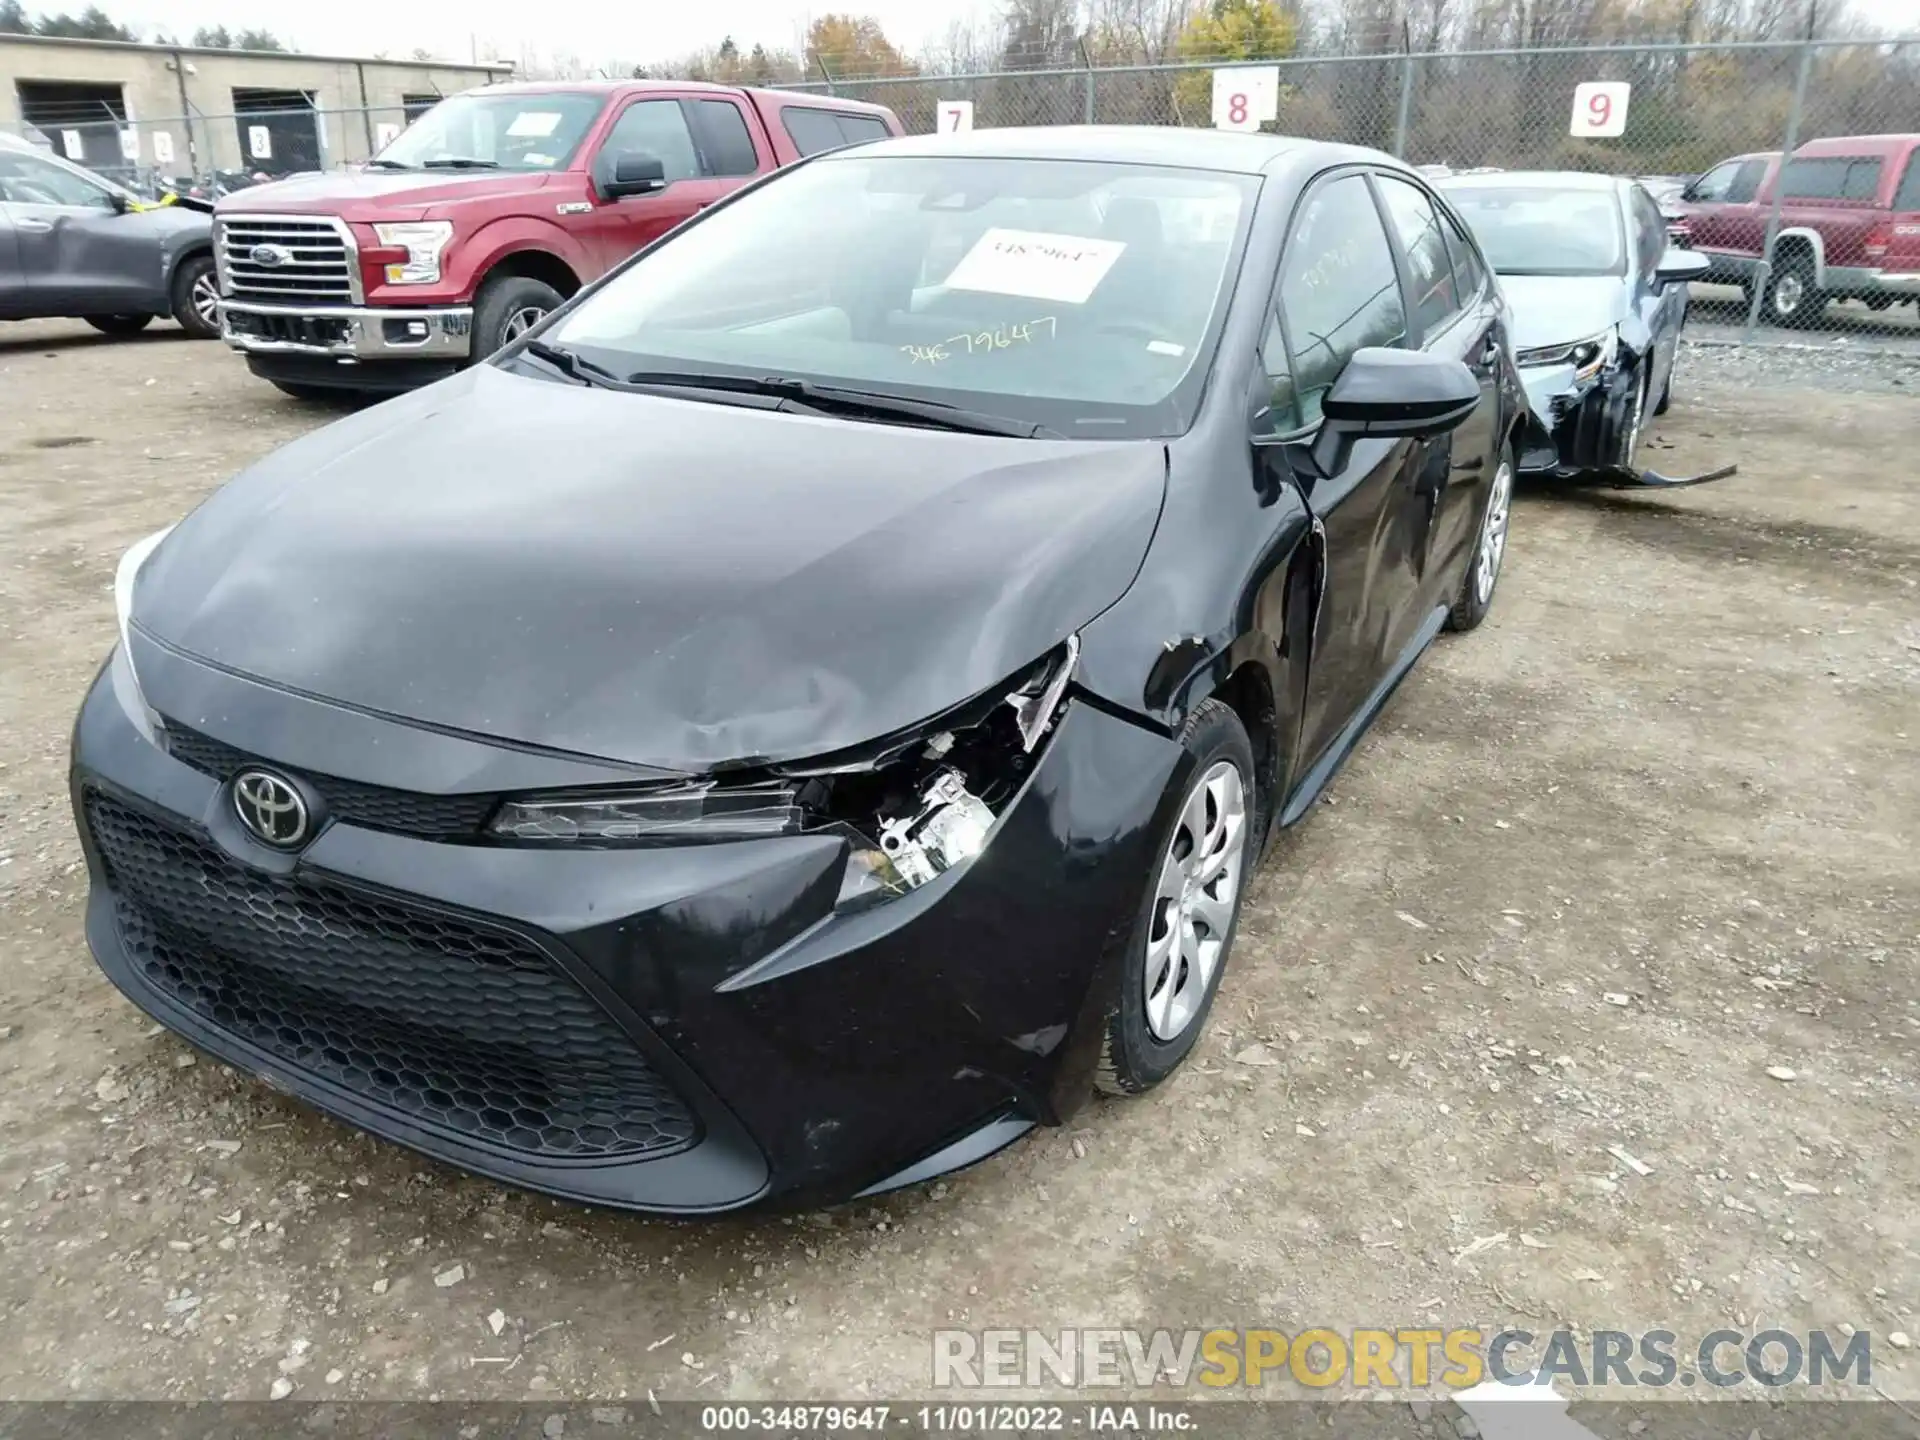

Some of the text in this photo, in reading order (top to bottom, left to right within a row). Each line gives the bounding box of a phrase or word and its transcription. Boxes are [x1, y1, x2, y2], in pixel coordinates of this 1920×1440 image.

[947, 109, 961, 133] 7
[1229, 93, 1247, 125] 8
[1588, 93, 1611, 127] 9
[255, 132, 265, 153] 3
